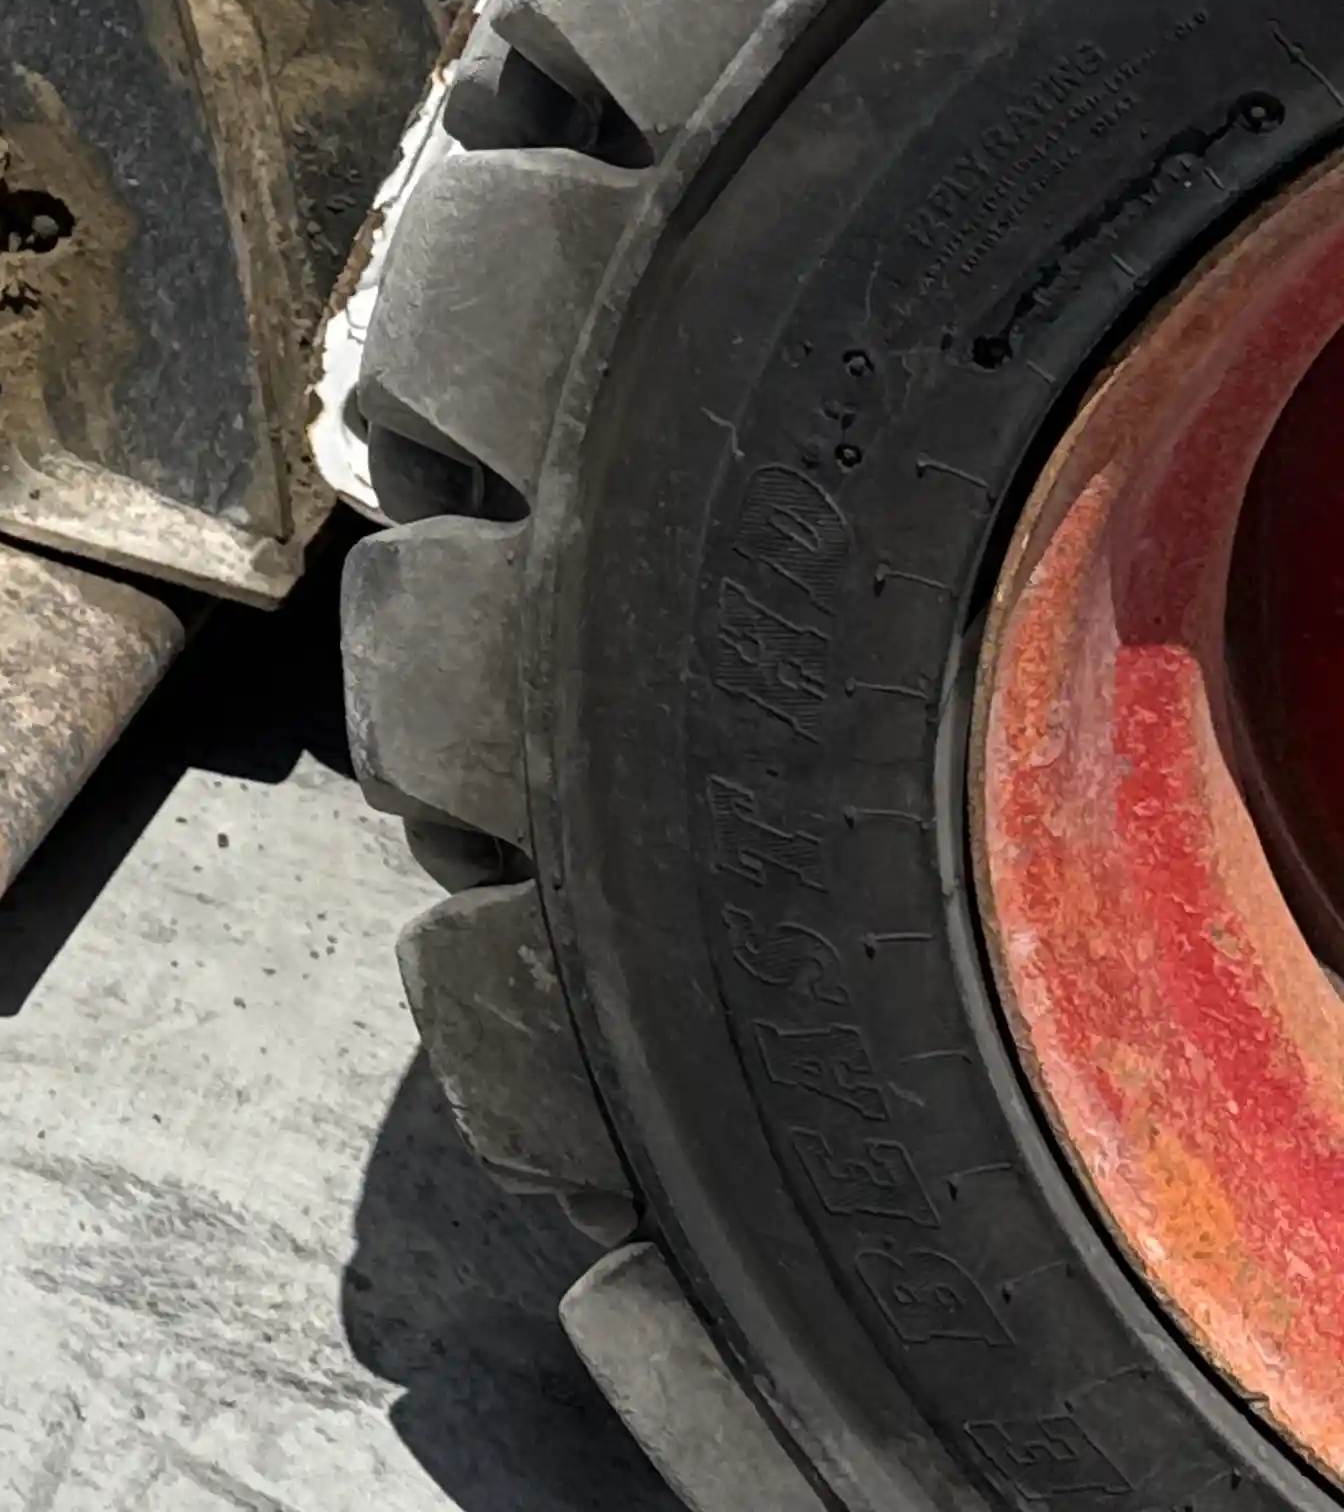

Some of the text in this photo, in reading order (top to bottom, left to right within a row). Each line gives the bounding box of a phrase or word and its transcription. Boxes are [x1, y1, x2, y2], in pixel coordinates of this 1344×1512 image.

[925, 147, 987, 216] PLY
[978, 37, 1110, 160] RATING
[715, 463, 850, 744] HD
[710, 770, 1016, 1348] BEAST
